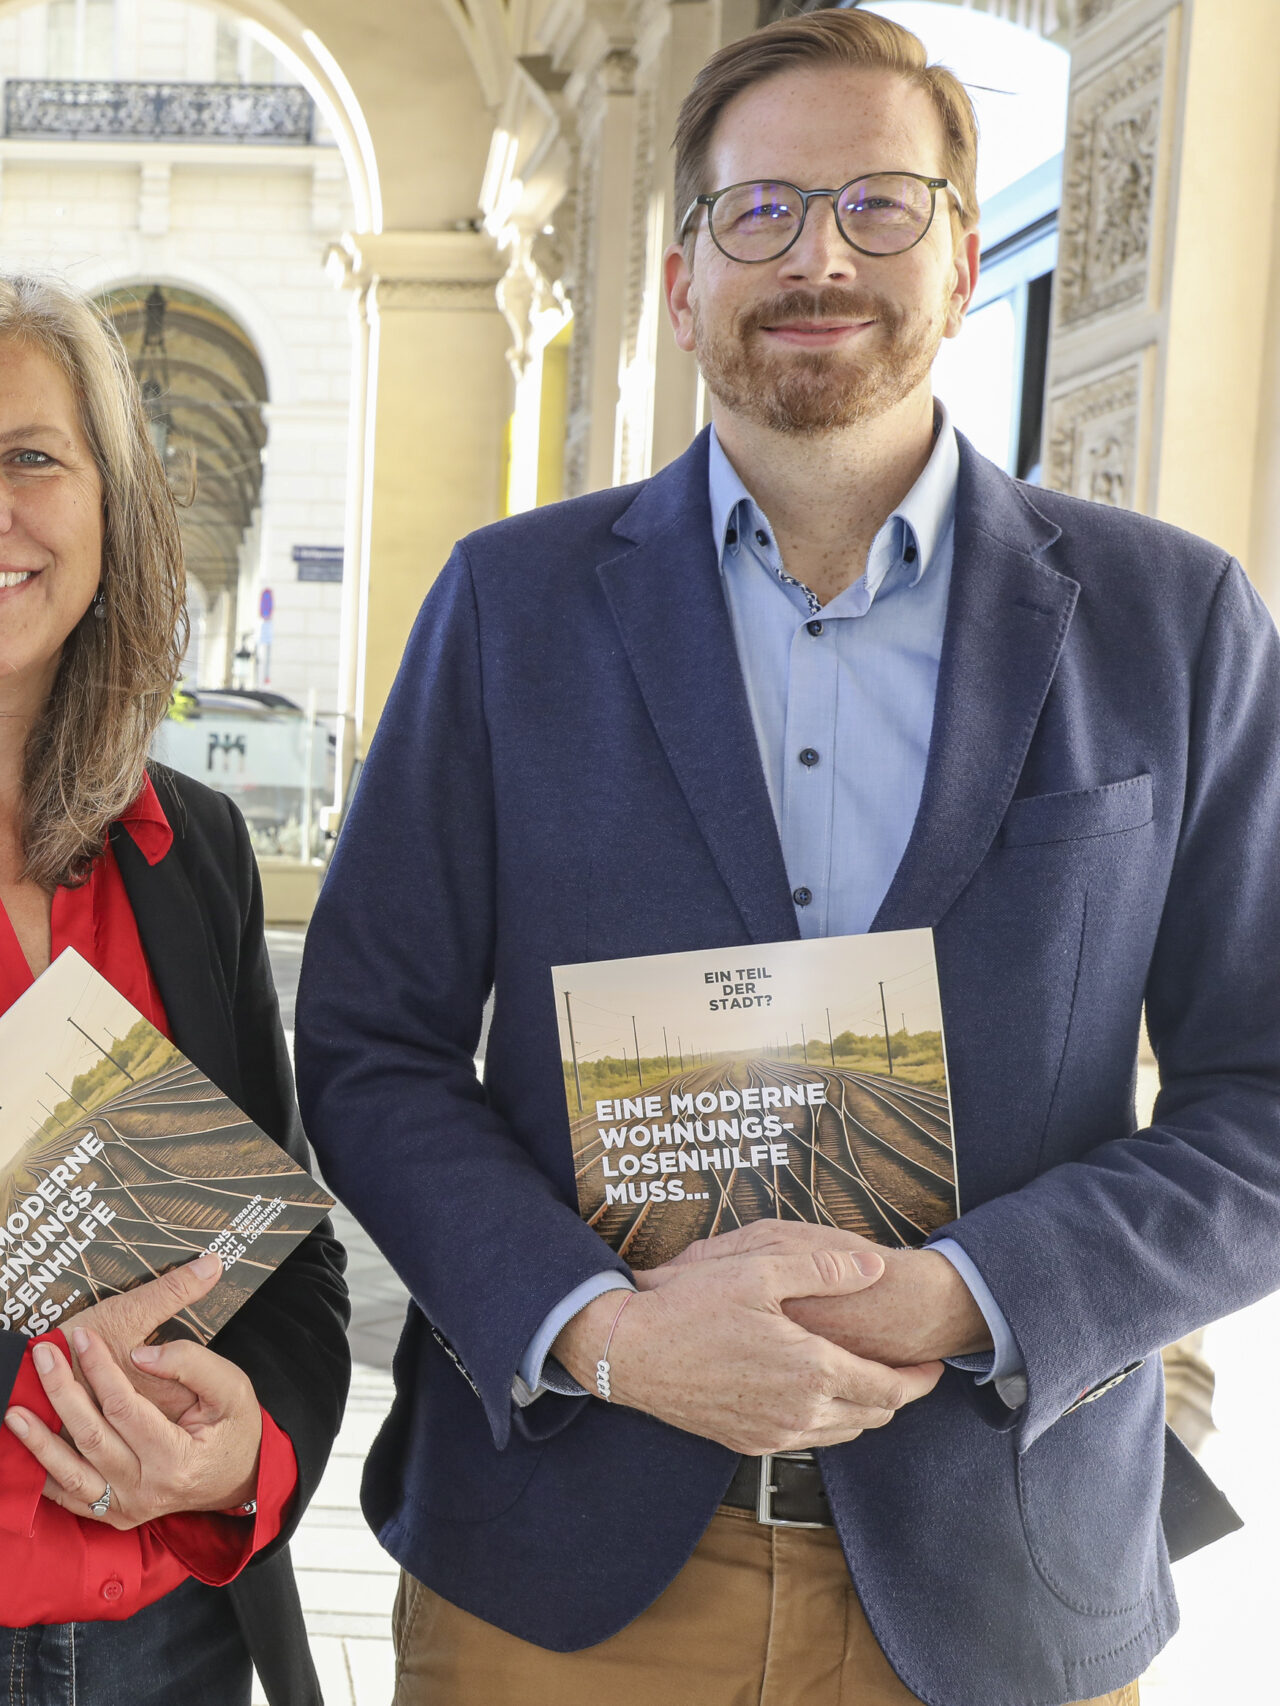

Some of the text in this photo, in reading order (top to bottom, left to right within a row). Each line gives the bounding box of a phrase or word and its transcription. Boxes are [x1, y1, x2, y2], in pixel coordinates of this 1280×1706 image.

[704, 967, 772, 984] EIN TEIL
[722, 982, 756, 996] DER
[709, 994, 772, 1011] STADT?
[596, 1083, 827, 1121] EINE MODERNE
[598, 1115, 794, 1149] WOHNUNGS-
[602, 1143, 790, 1177] LOSENHILFE
[605, 1179, 710, 1205] MUSS...
[229, 1194, 262, 1227] VERBAND
[236, 1205, 263, 1232] WIENER
[241, 1196, 282, 1238] WOHNUNGS-
[246, 1202, 287, 1244] LOSENHILFE
[222, 1243, 247, 1271] 2025
